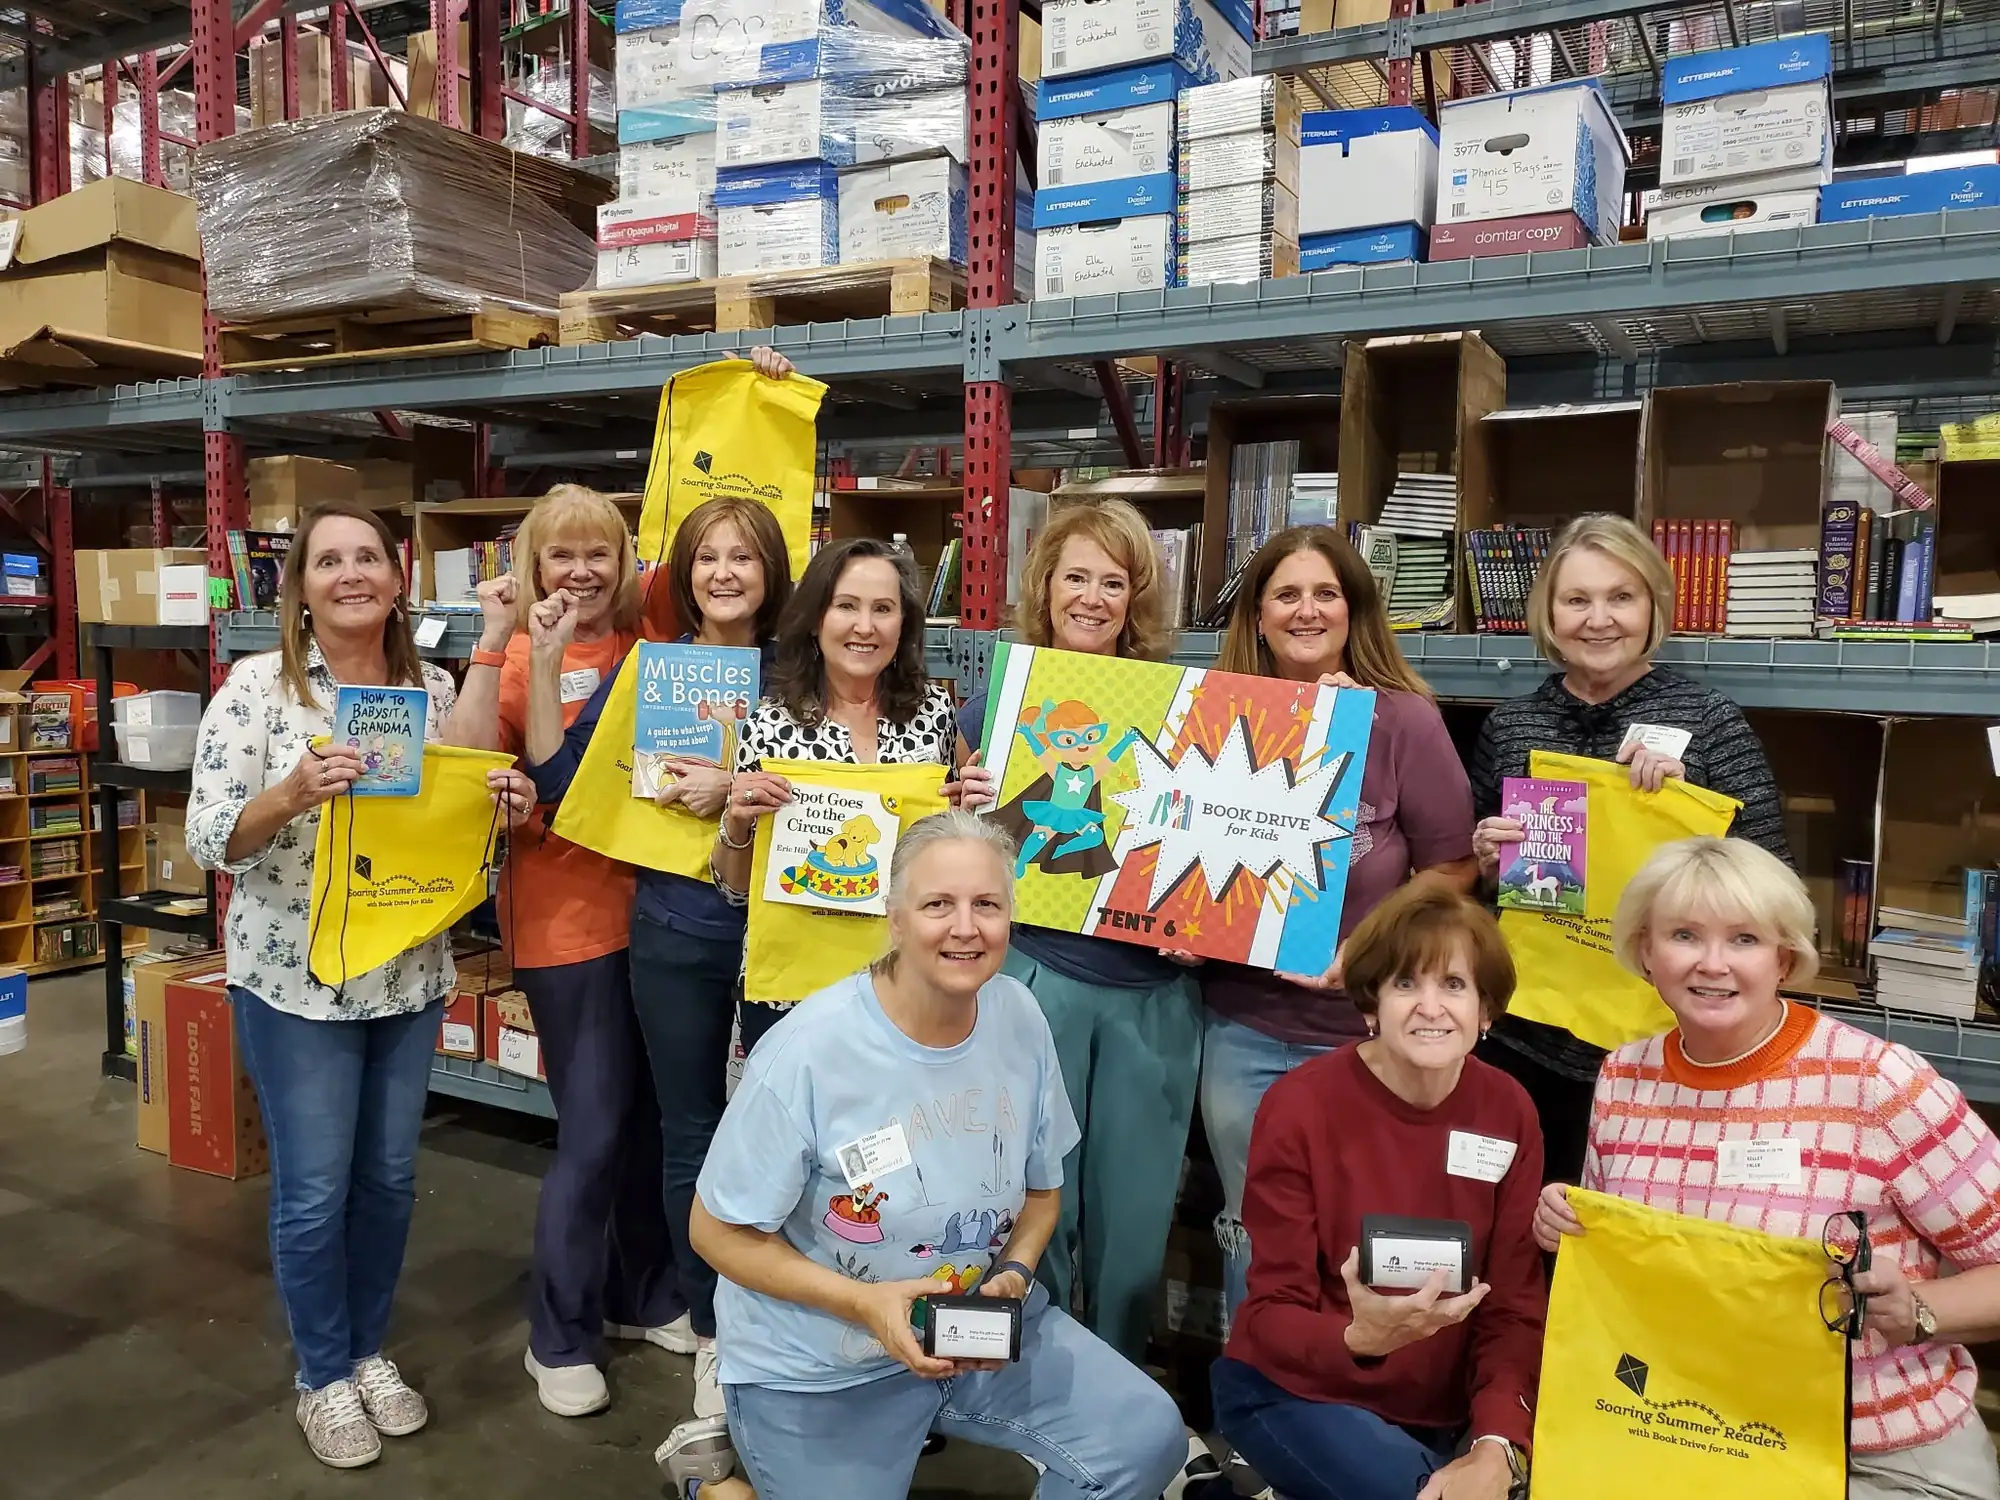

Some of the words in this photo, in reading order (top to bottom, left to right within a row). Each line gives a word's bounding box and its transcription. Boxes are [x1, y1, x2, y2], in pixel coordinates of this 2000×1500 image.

[1076, 27, 1118, 46] Enchanted
[1678, 68, 1734, 84] LETTERMARK
[1049, 89, 1095, 103] LETTERMARK
[1675, 104, 1706, 118] 3973
[1453, 145, 1480, 156] 3977
[1075, 156, 1114, 169] Enchanted
[1472, 166, 1508, 179] Phonics
[1513, 162, 1540, 178] Bags
[1483, 179, 1508, 196] 45
[1648, 188, 1683, 205] BASIC
[1686, 186, 1718, 199] DUTY
[1046, 199, 1091, 212] LETTERMARK
[1841, 195, 1902, 209] LETTERMARK
[1951, 191, 1983, 203] Domtar
[627, 225, 655, 238] Opaque
[656, 222, 679, 234] Digital
[1475, 231, 1522, 244] domtar
[1526, 226, 1562, 241] copy
[1074, 269, 1115, 283] Enchanted
[681, 478, 715, 490] Soaring
[716, 482, 752, 494] Summer
[753, 487, 783, 501] Readers
[1504, 571, 1512, 583] BAD
[1870, 561, 1879, 582] PETER
[1500, 583, 1508, 599] GUYS
[1869, 582, 1878, 593] PAN
[644, 657, 751, 685] Muscles
[361, 690, 385, 704] HOW
[390, 694, 406, 706] TO
[644, 681, 662, 703] &
[672, 682, 750, 708] Bones
[352, 703, 401, 719] BABYSIT
[402, 710, 410, 720] A
[347, 720, 412, 738] GRANDMA
[647, 727, 652, 736] A
[653, 727, 672, 739] guide
[673, 727, 680, 735] to
[680, 726, 696, 736] what
[696, 724, 714, 735] keeps
[656, 738, 668, 749] you
[669, 738, 677, 749] up
[678, 737, 690, 746] and
[691, 735, 709, 746] about
[615, 759, 634, 773] Soar
[791, 787, 825, 807] Spot
[828, 792, 864, 810] Goes
[806, 806, 821, 820] to
[823, 807, 846, 822] the
[1201, 802, 1252, 822] BOOK
[1256, 811, 1311, 832] DRIVE
[1540, 803, 1554, 815] THE
[787, 817, 835, 837] Circus
[1520, 813, 1574, 833] PRINCESS
[1224, 823, 1248, 840] for
[1249, 826, 1280, 842] Kids
[1529, 830, 1546, 842] AND
[1548, 832, 1563, 844] THE
[776, 844, 793, 854] Eric
[795, 845, 809, 855] Hill
[1519, 841, 1572, 861] UNICORN
[348, 887, 378, 900] Soaring
[379, 885, 416, 898] Summer
[418, 883, 455, 895] Readers
[378, 899, 393, 908] Book
[394, 898, 410, 907] Drive
[410, 898, 419, 907] for
[419, 897, 434, 905] Kids
[827, 909, 843, 917] Book
[1097, 906, 1157, 934] TENT
[1163, 920, 1177, 938] 6
[1542, 912, 1583, 933] Soaring
[1583, 924, 1612, 942] Sum
[1565, 933, 1580, 944] with
[1580, 938, 1598, 950] Book
[187, 1021, 200, 1083] BOOK
[188, 1085, 202, 1135] FAIR
[878, 1088, 988, 1150] AVE
[1000, 1086, 1018, 1135] A
[1595, 1398, 1654, 1424] Soaring
[1656, 1412, 1721, 1436] Summer
[1724, 1424, 1787, 1451] Readers
[1628, 1426, 1650, 1440] with
[1652, 1431, 1678, 1445] Book
[1680, 1436, 1706, 1451] Drive
[1707, 1443, 1725, 1455] for
[1726, 1446, 1750, 1459] Kids
